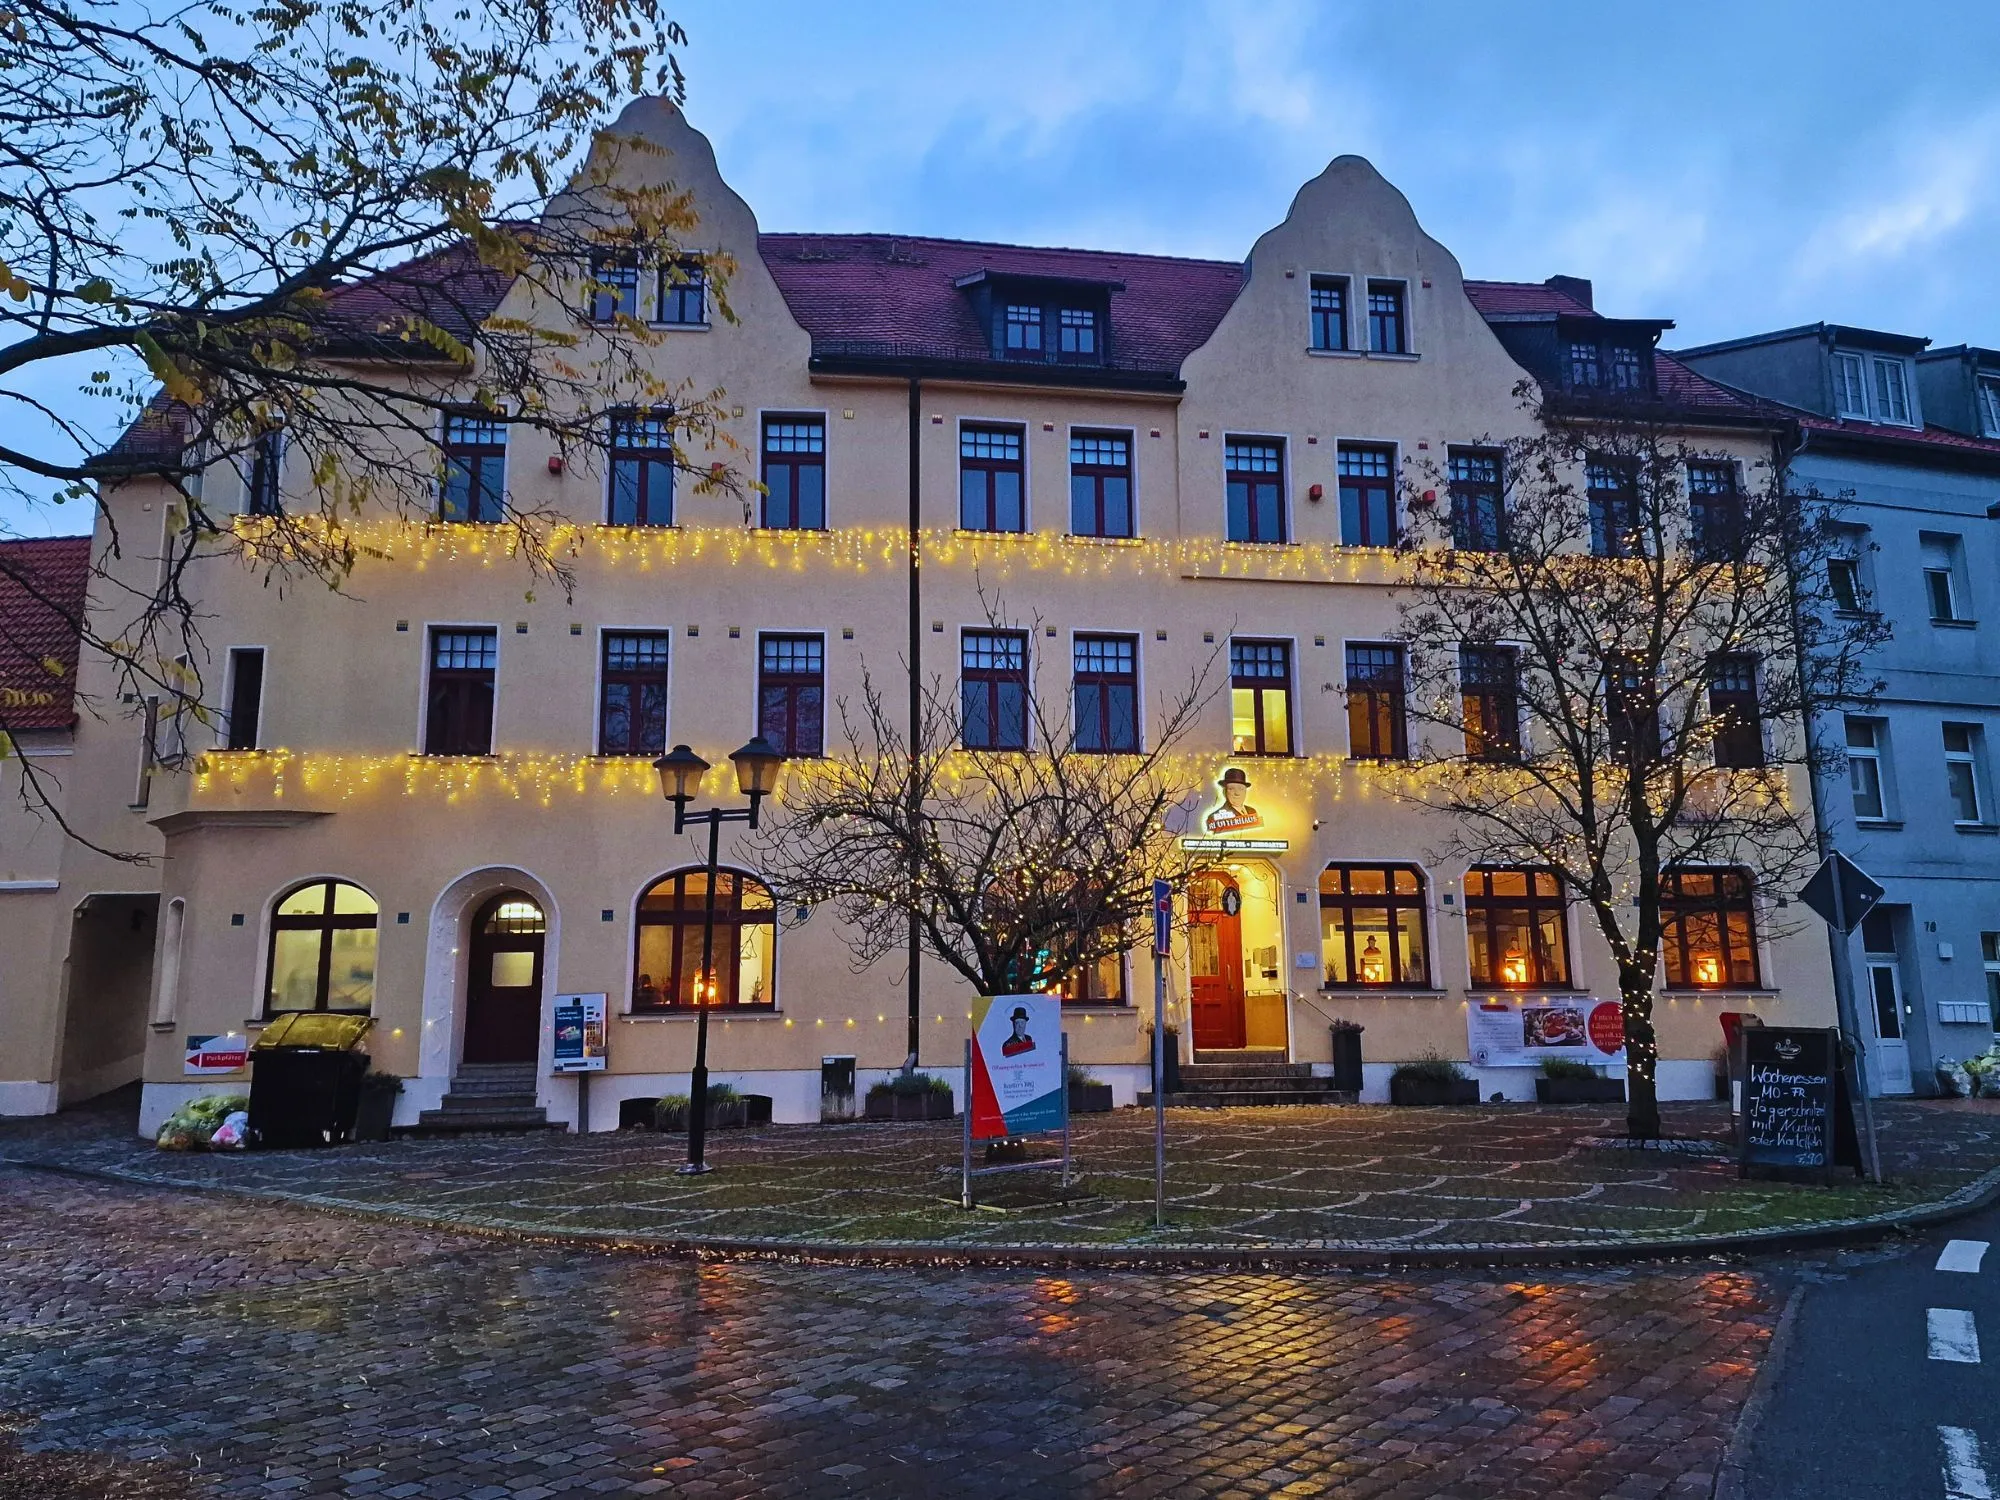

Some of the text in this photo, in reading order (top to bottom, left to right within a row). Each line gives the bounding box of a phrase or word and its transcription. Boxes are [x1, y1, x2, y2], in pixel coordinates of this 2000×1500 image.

[1751, 1064, 1827, 1084] Wochenessen
[1762, 1084, 1781, 1099] MO
[1790, 1086, 1806, 1098] FR
[1752, 1117, 1821, 1132] mit Nudeln
[1749, 1131, 1775, 1146] oder
